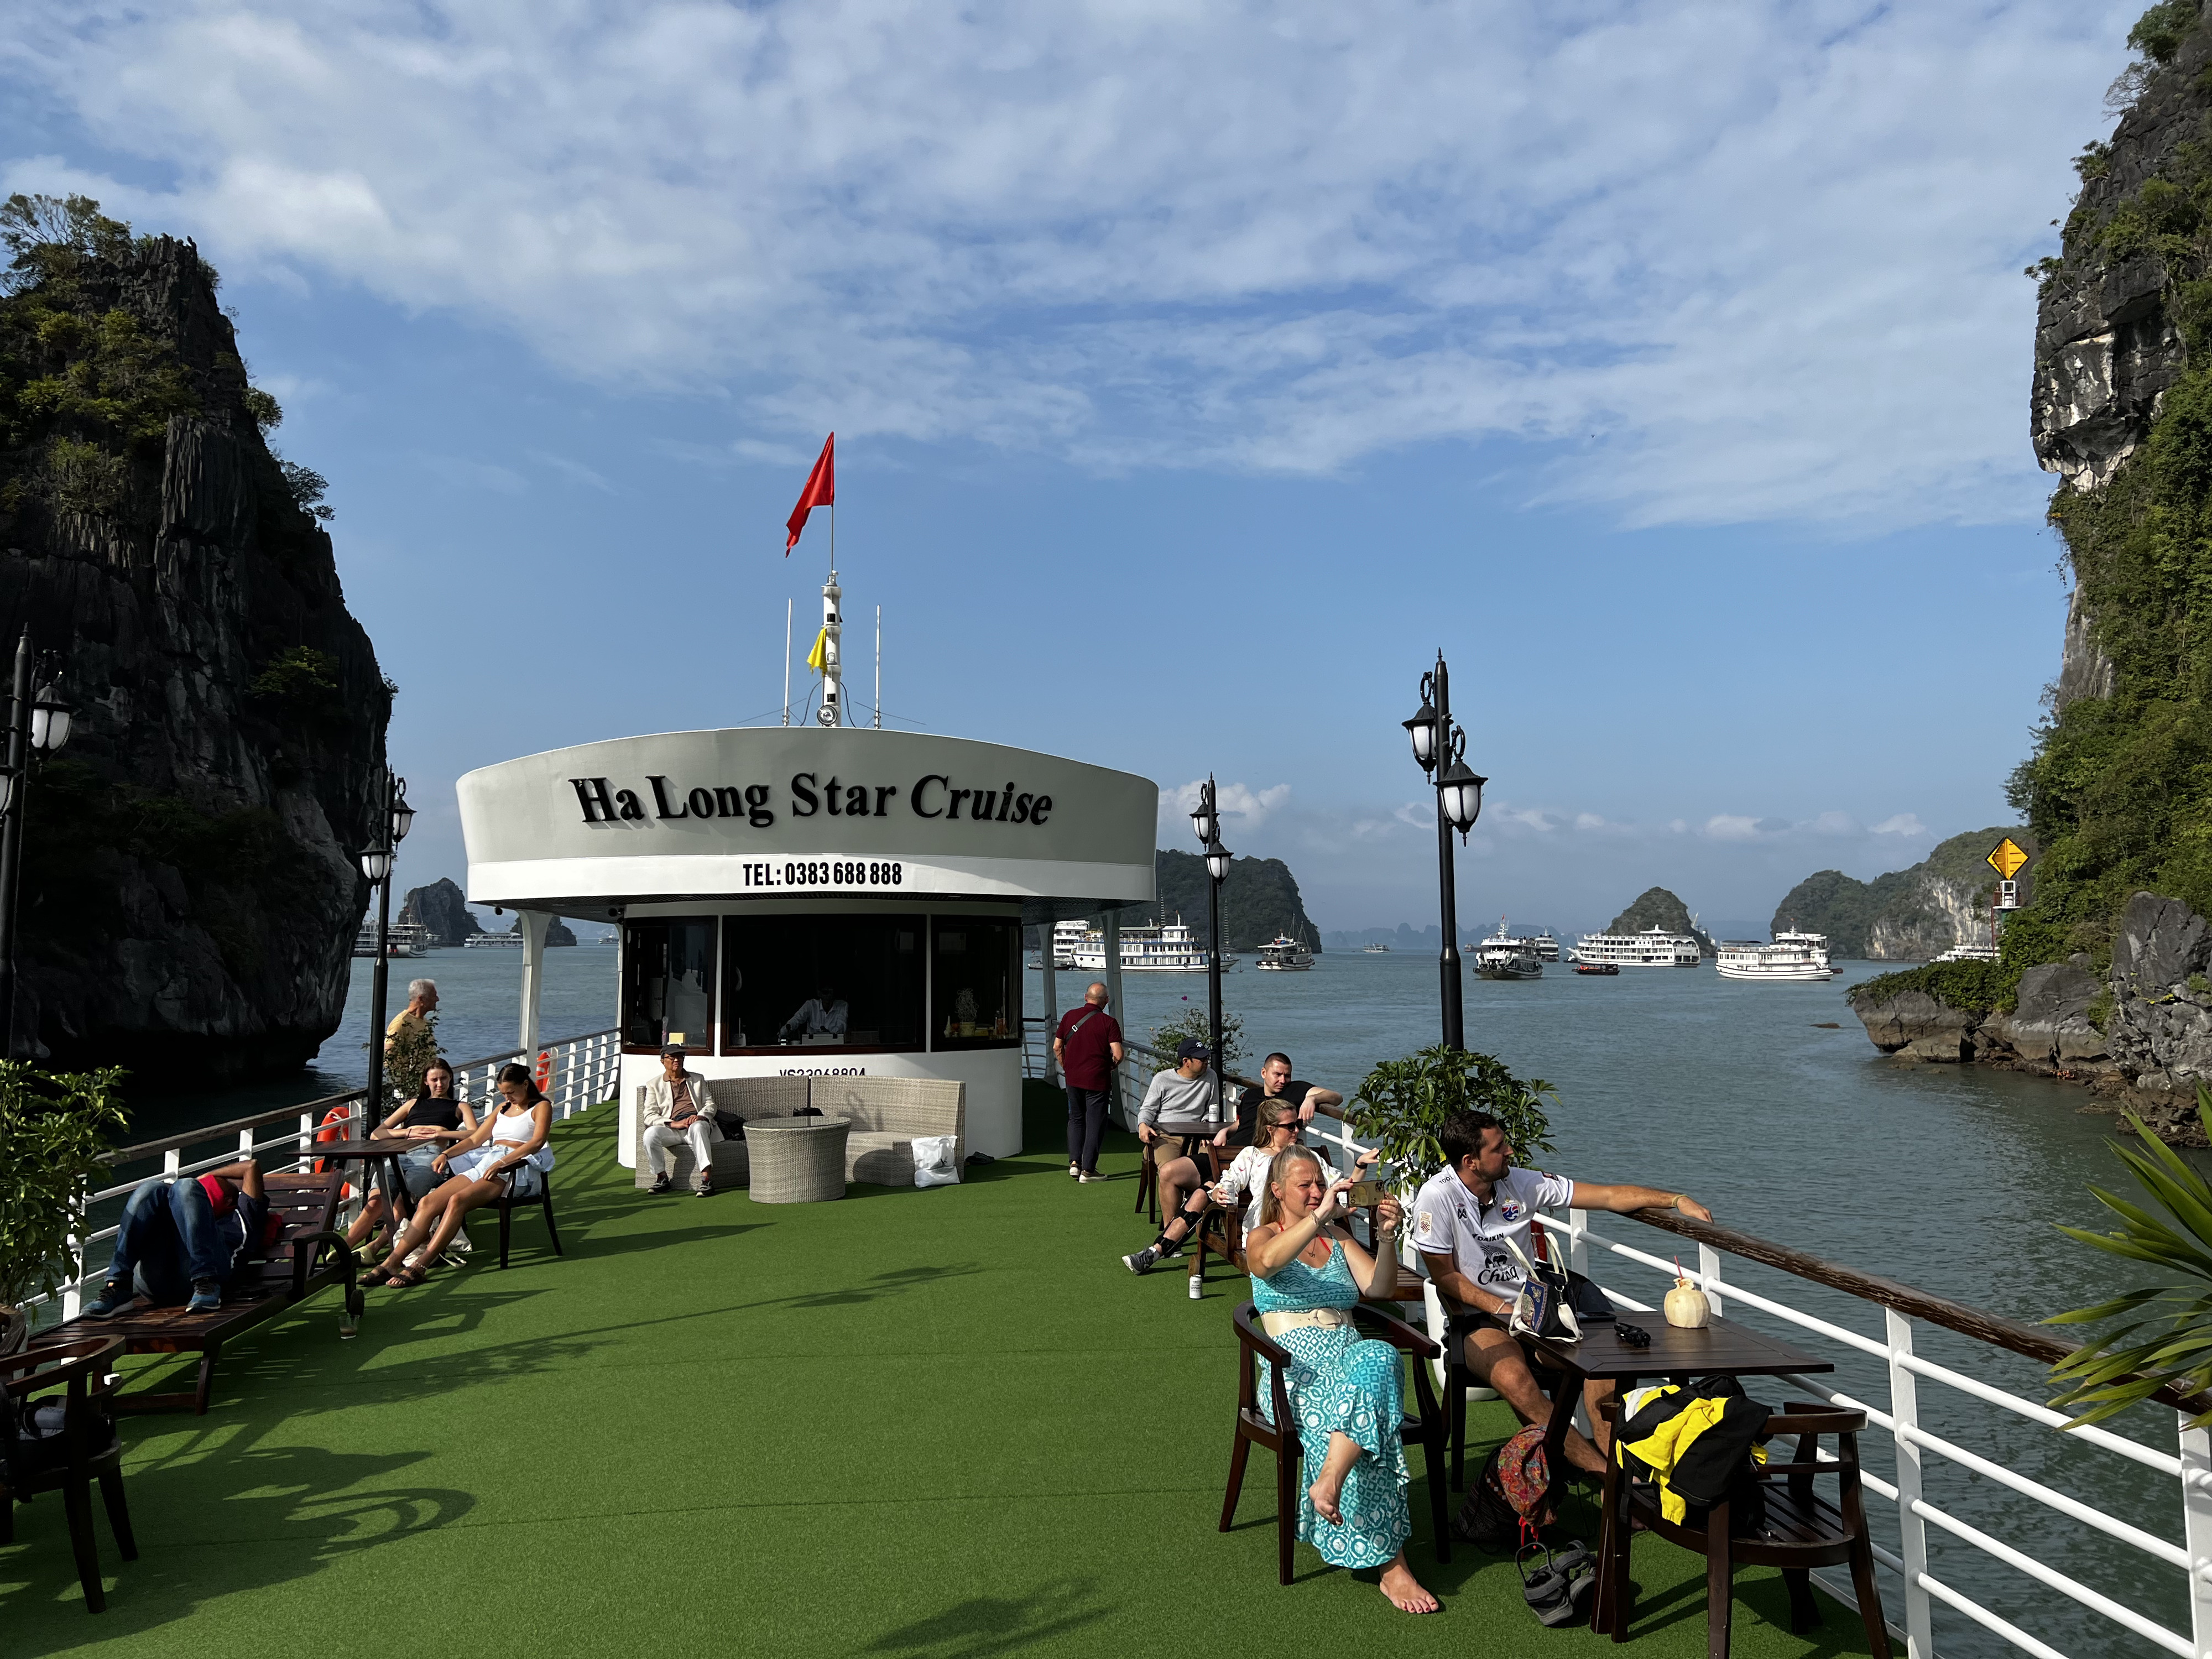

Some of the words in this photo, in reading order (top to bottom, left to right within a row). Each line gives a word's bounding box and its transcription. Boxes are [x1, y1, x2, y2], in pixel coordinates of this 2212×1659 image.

[568, 777, 644, 822] Ha
[645, 775, 774, 828] Long
[791, 773, 896, 817] Star
[911, 774, 1052, 825] Cruise
[870, 863, 901, 885] 888
